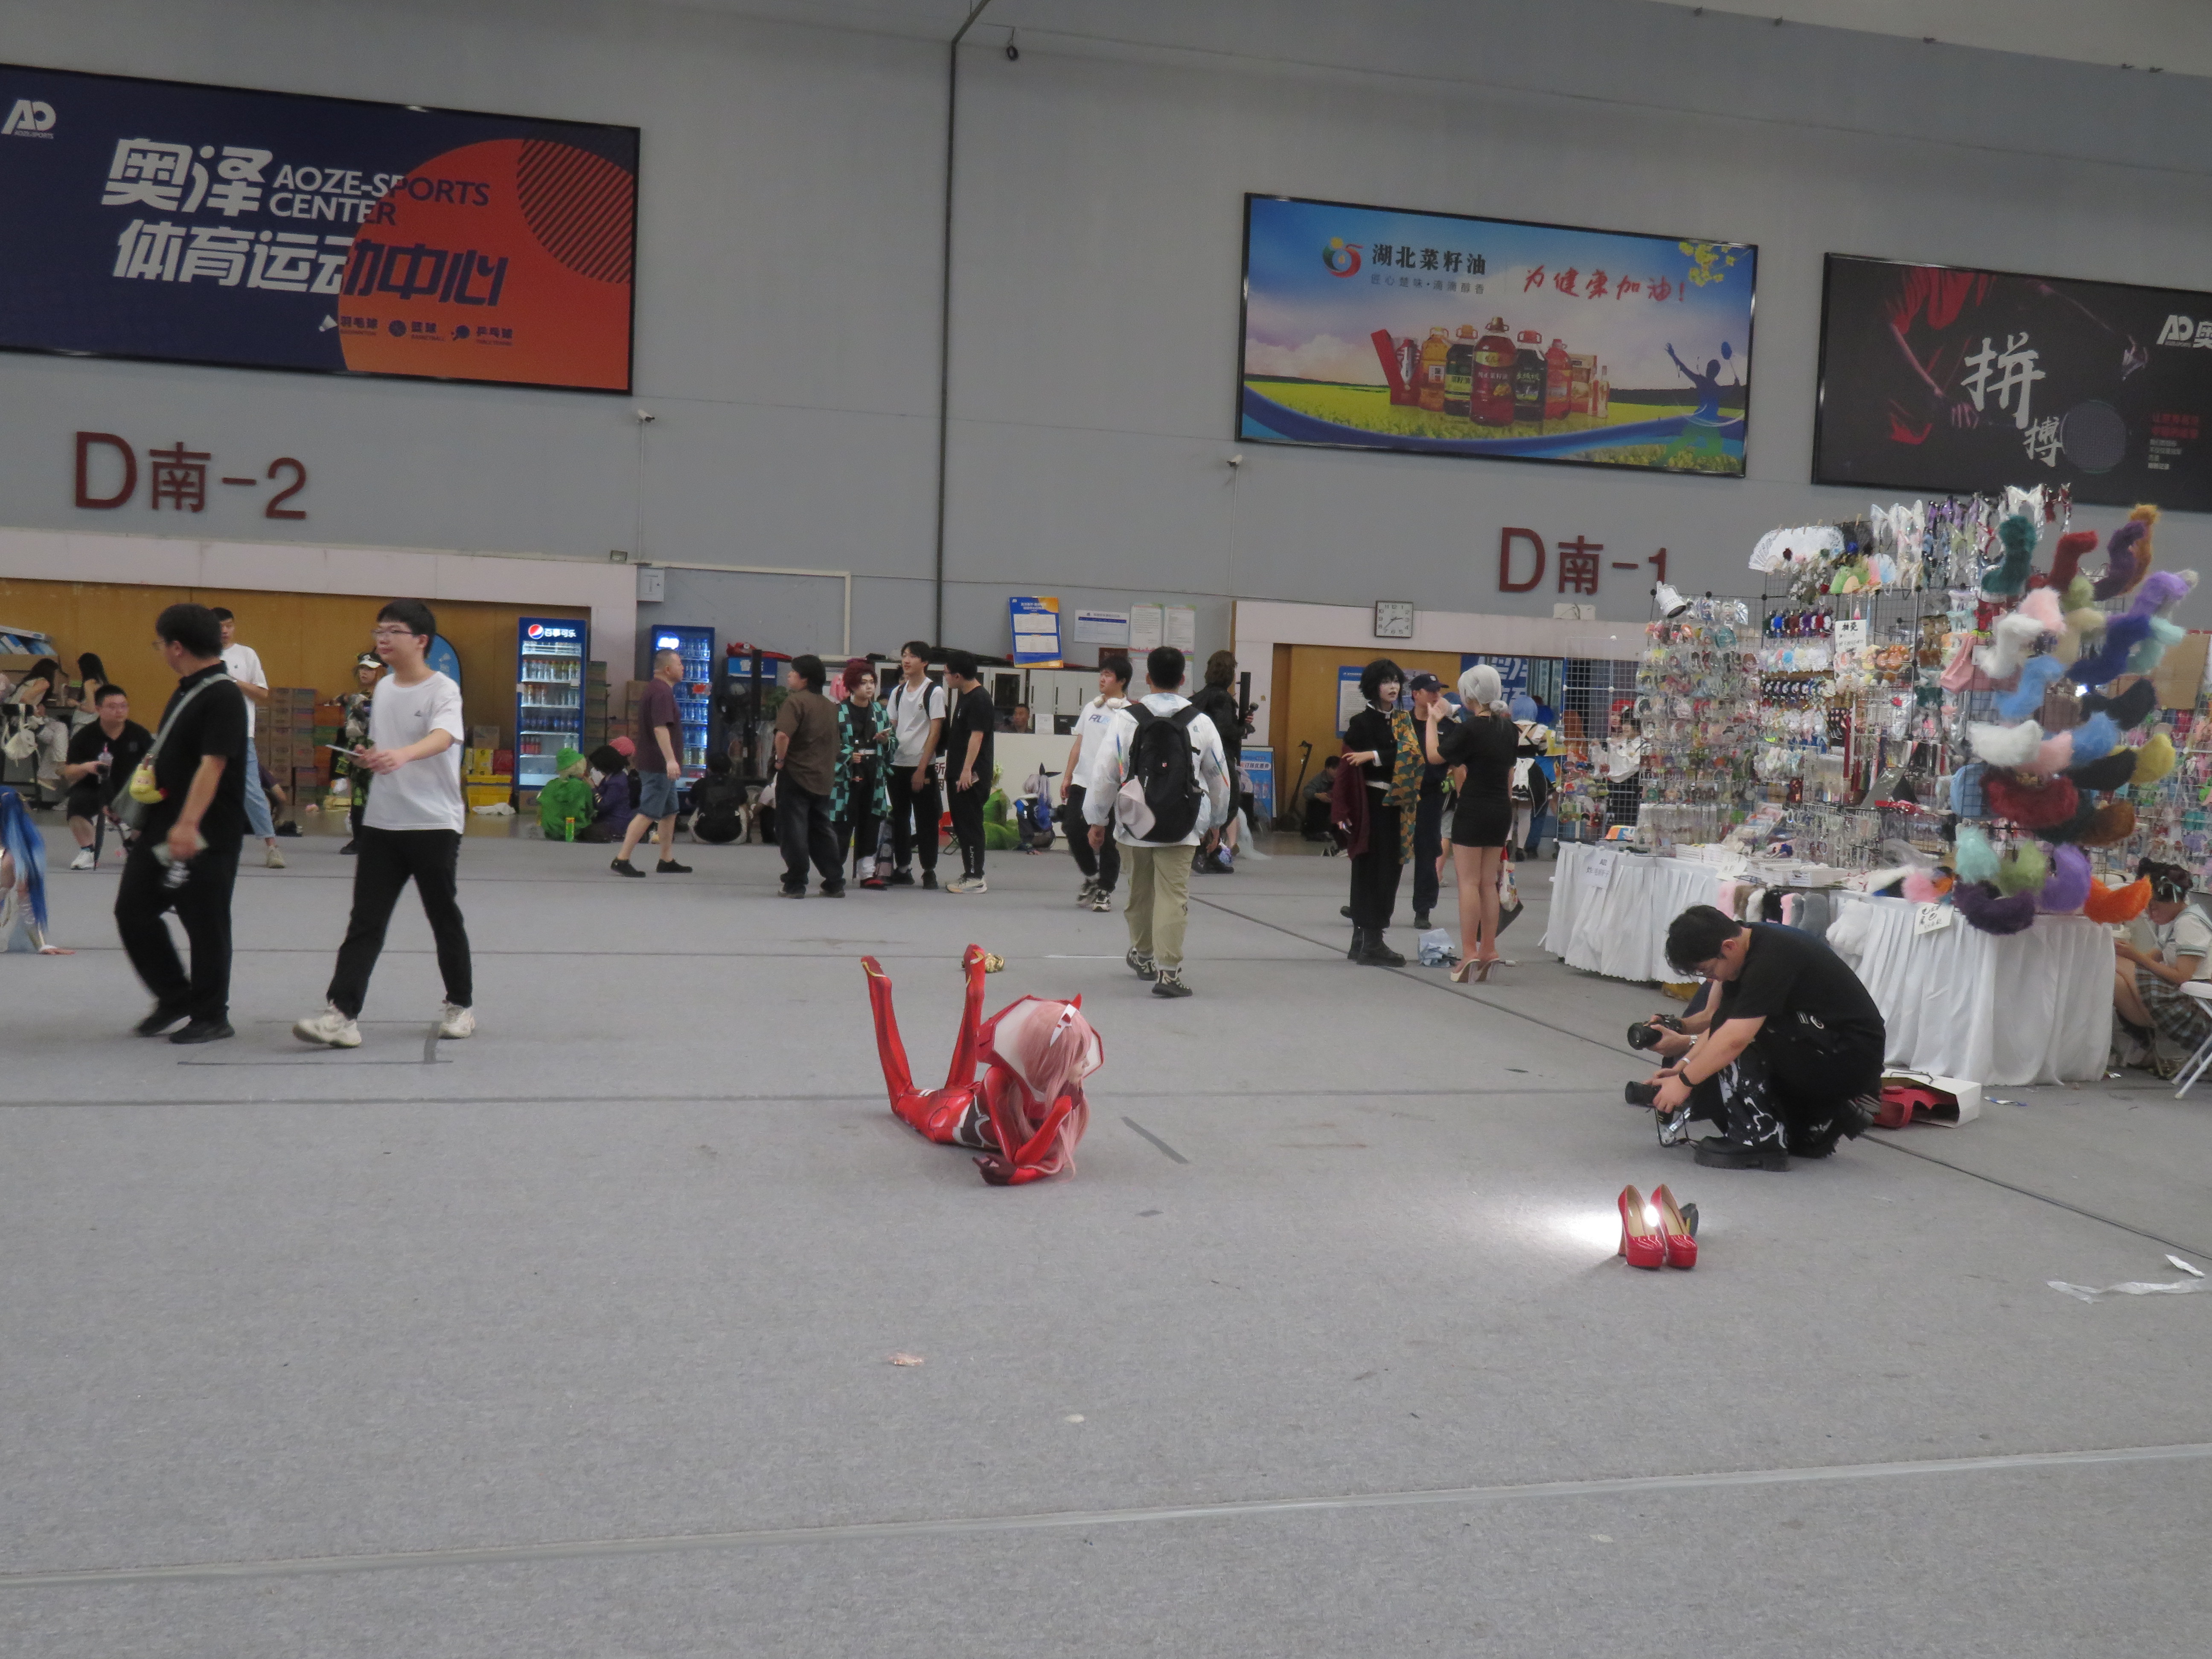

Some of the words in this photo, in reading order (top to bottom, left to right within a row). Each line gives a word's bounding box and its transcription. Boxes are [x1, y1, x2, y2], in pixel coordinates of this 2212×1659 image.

[101, 138, 273, 217] 奥泽
[273, 164, 491, 207] AOZE-SPORTS
[269, 193, 396, 226] CENTER
[113, 219, 509, 306] 体育运动中心
[1372, 244, 1486, 275] 湖北菜籽油
[544, 628, 576, 639] 百事可乐
